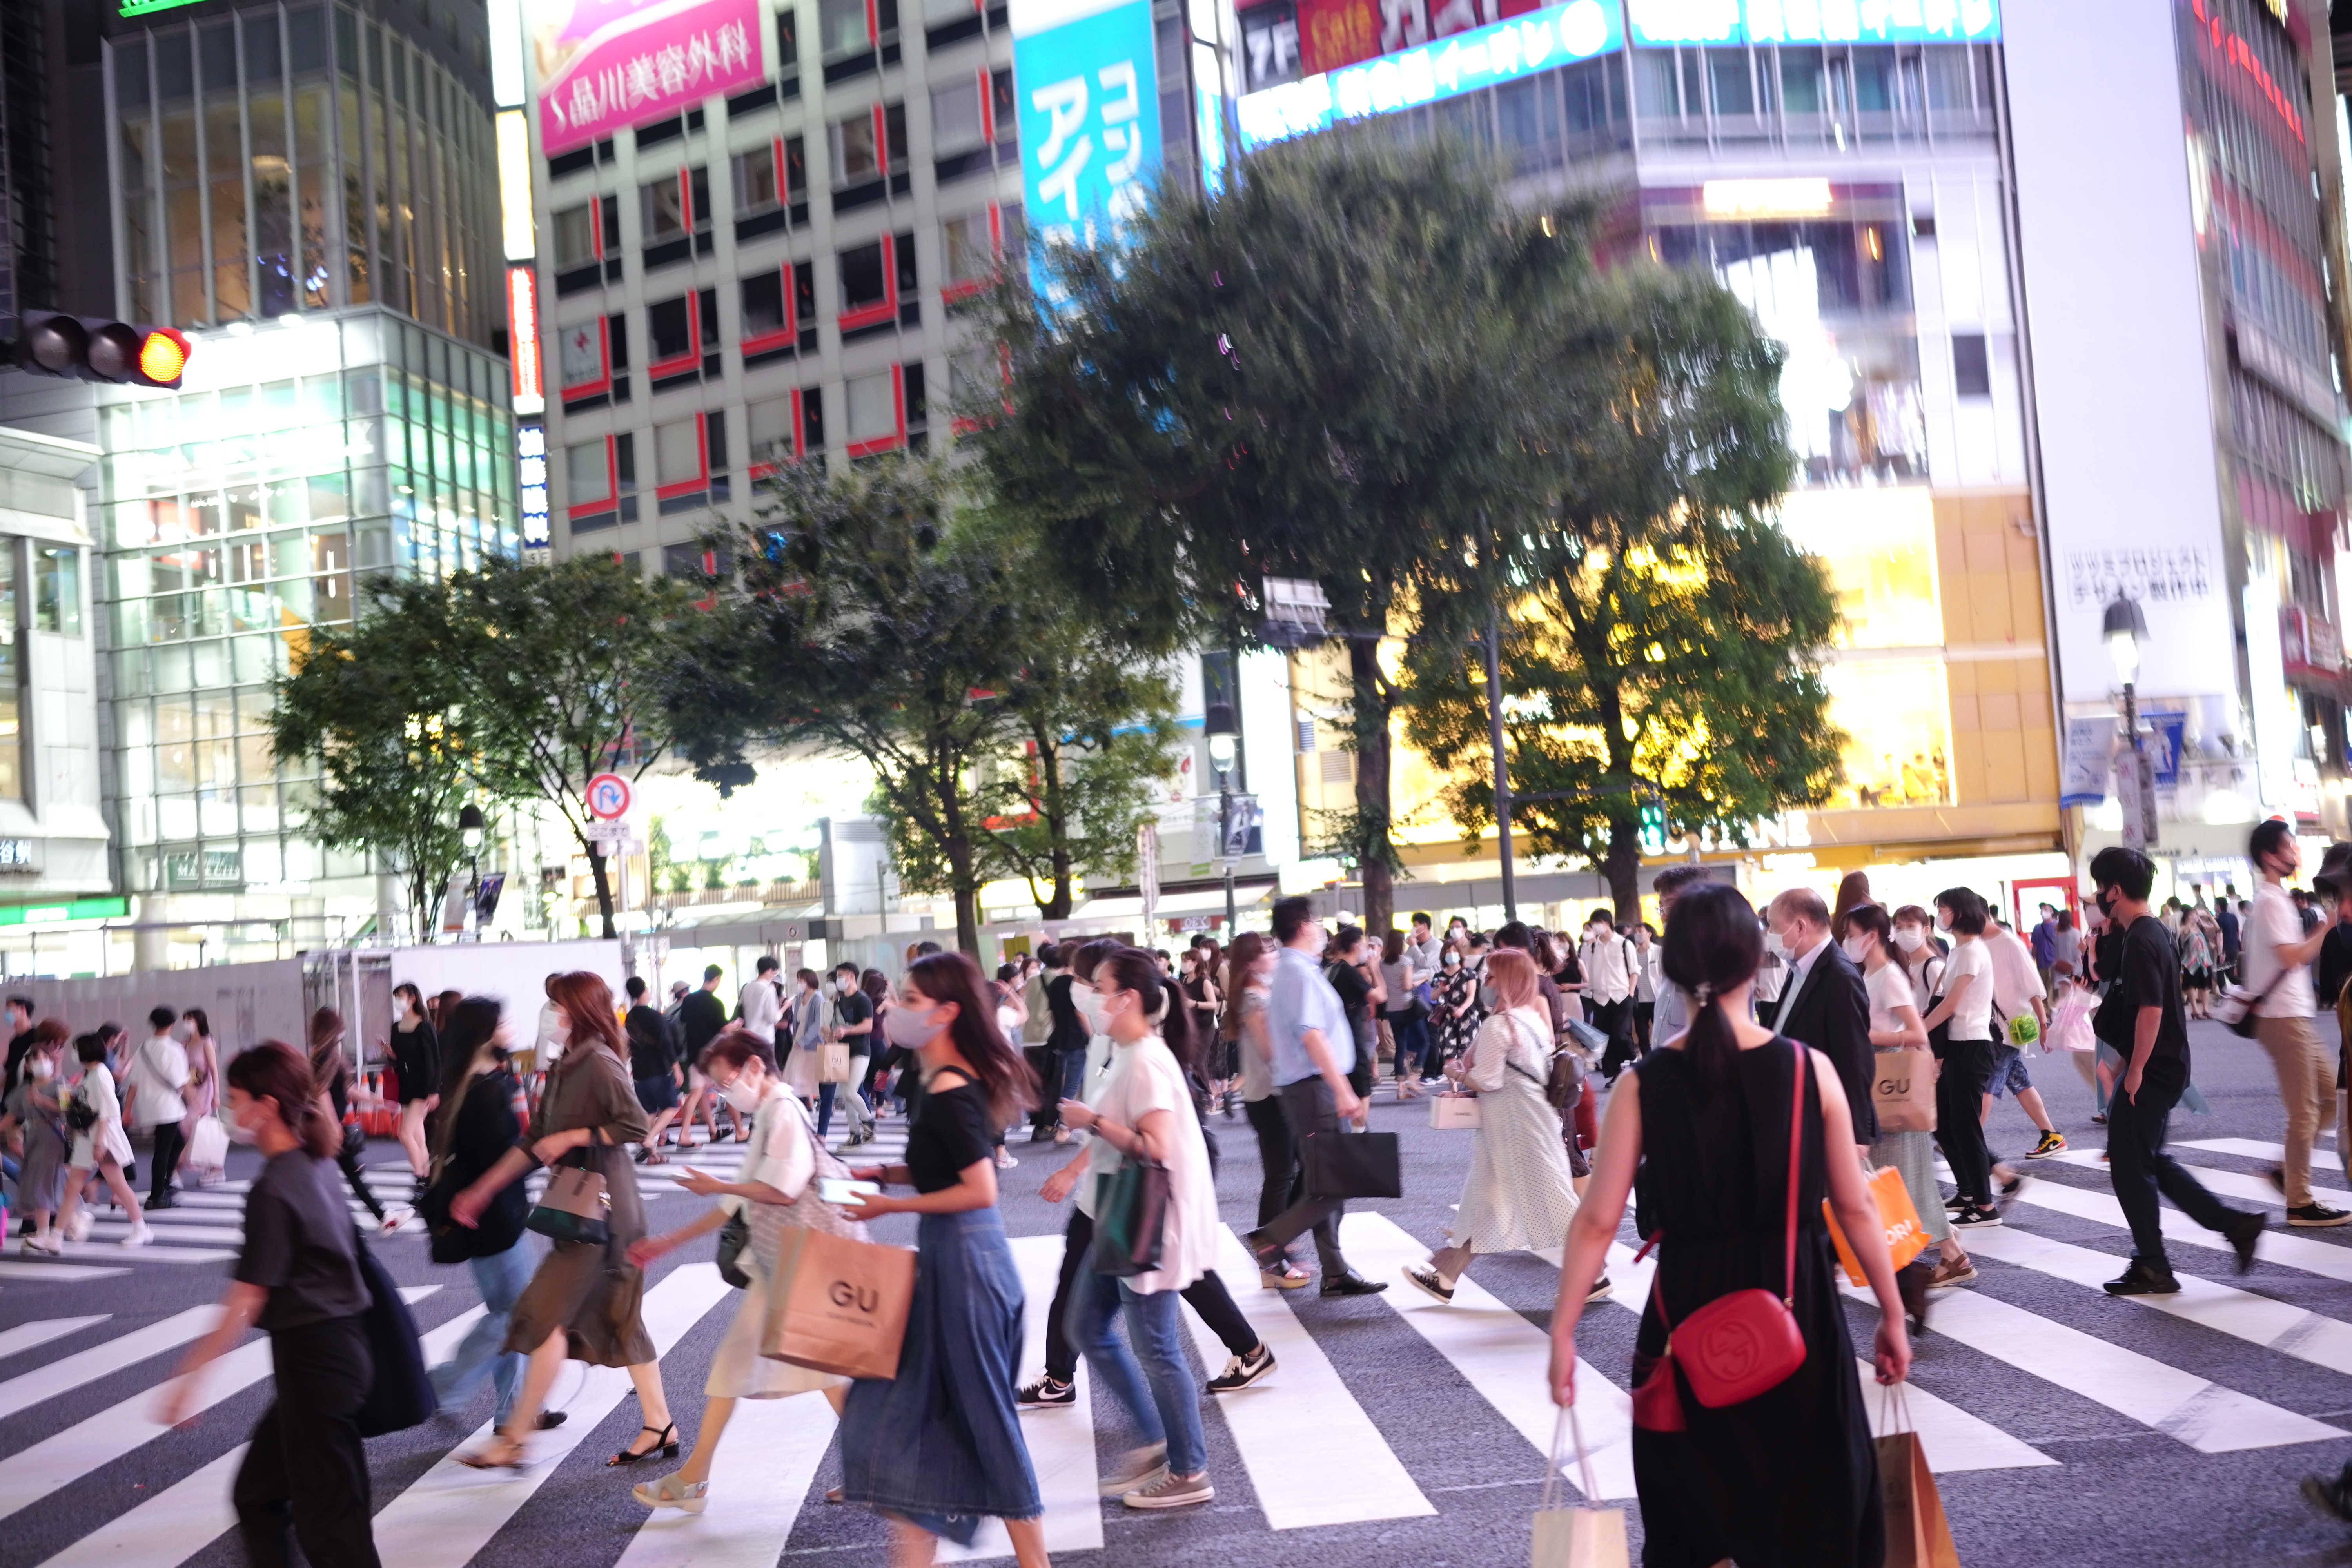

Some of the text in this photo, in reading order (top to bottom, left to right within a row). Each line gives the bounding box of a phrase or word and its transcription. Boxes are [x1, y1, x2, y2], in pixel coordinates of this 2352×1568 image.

[569, 18, 751, 129] 品川美容外科
[590, 827, 629, 837] ここまで
[831, 1055, 842, 1065] GU
[1878, 1078, 1910, 1095] GU
[828, 1279, 879, 1313] GU
